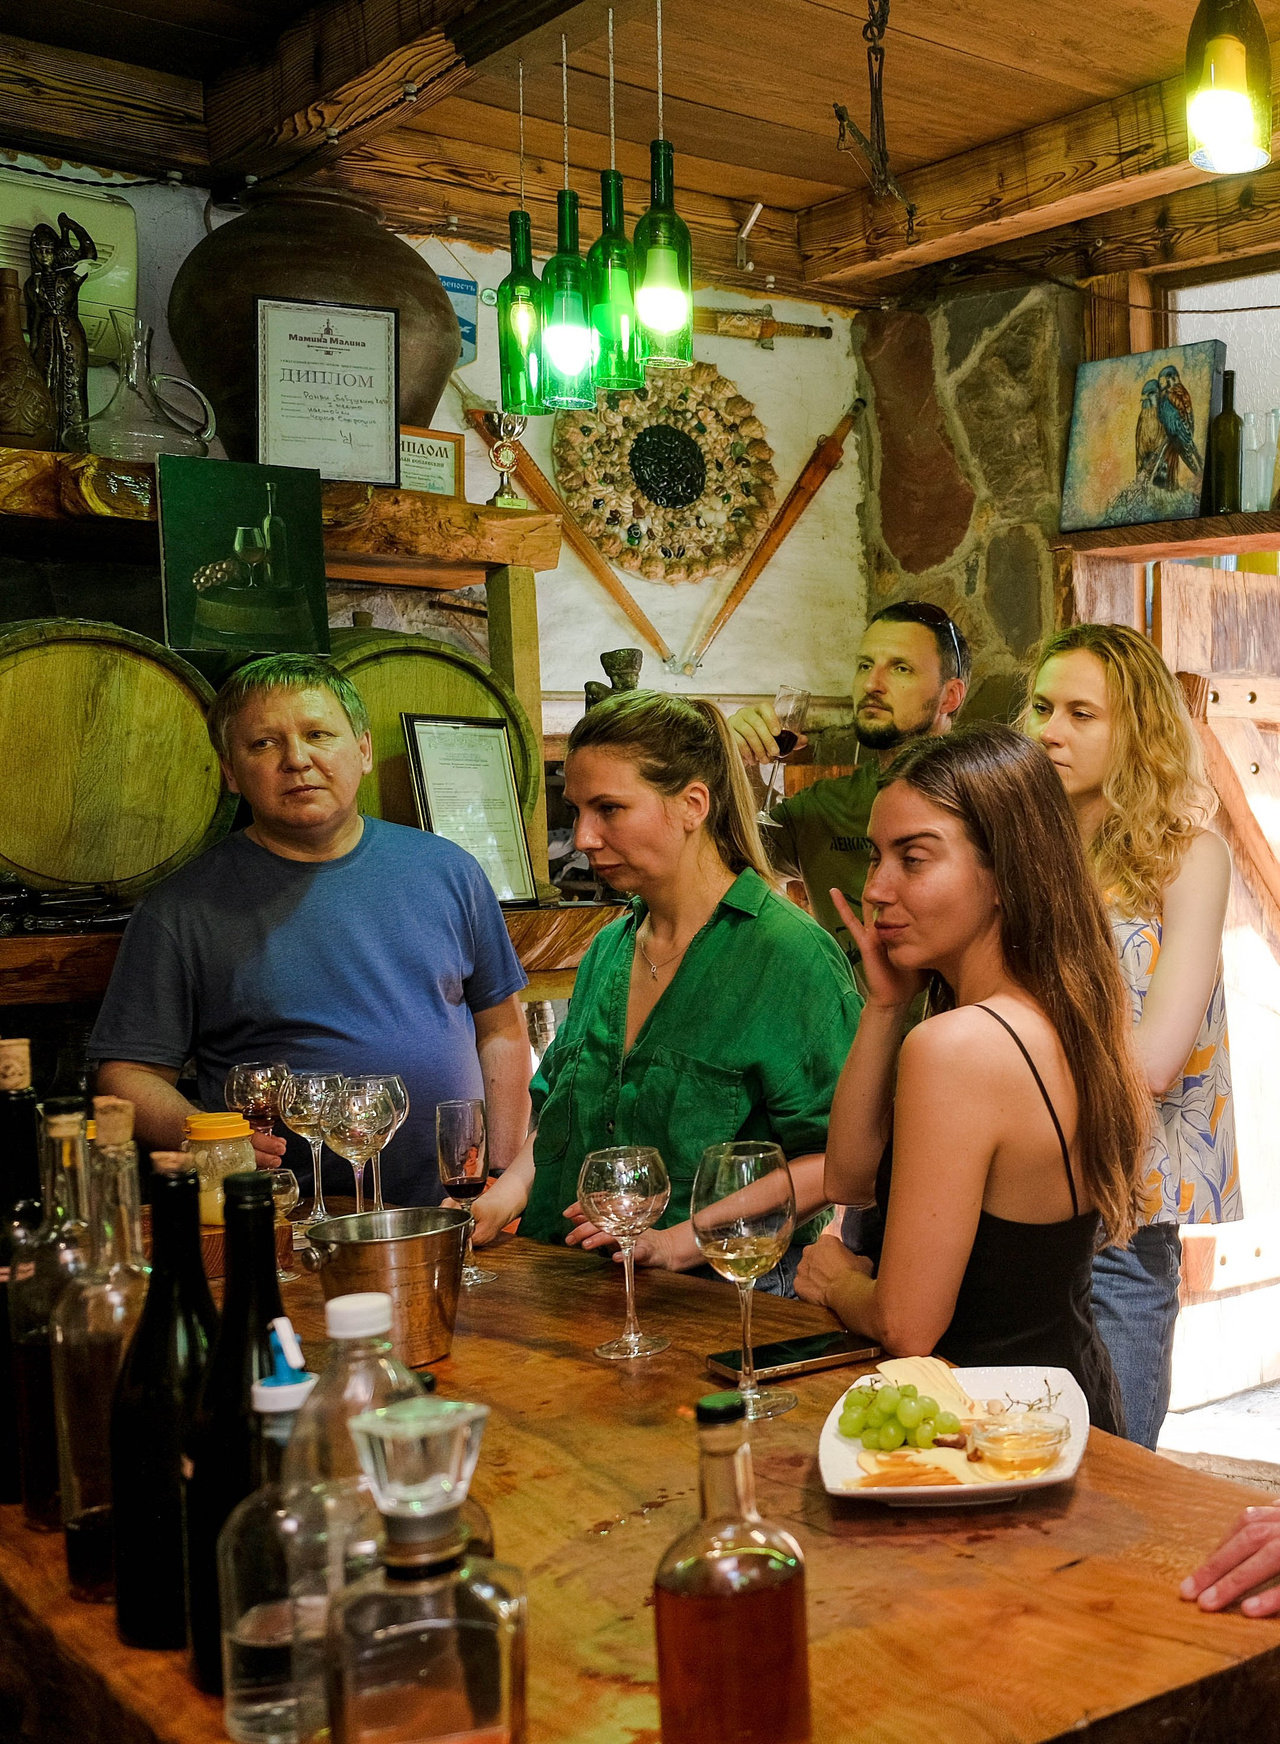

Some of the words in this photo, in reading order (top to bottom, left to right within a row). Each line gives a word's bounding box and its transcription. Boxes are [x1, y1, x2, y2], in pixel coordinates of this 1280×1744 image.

[288, 333, 328, 344] Мамина
[329, 337, 366, 347] Малина
[280, 368, 374, 388] ДИПЛОМ
[400, 440, 449, 459] ИПЛОМ
